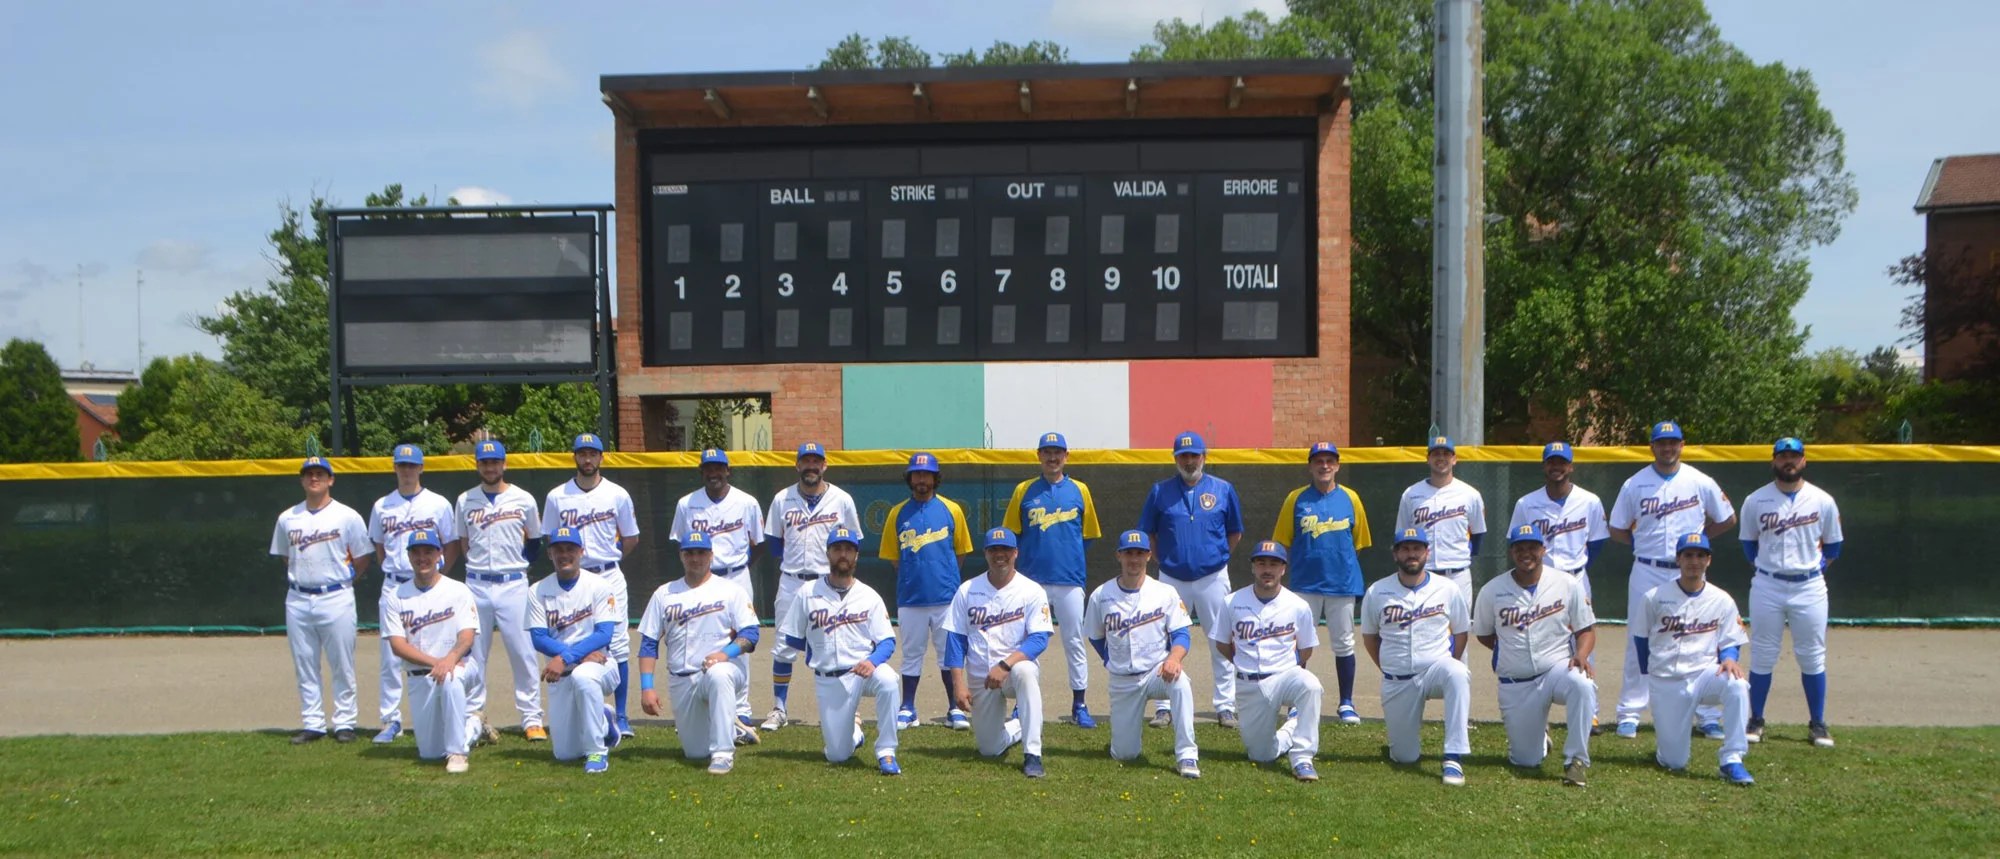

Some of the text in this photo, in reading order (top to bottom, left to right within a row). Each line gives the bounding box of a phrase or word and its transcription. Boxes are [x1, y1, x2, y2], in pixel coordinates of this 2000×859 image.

[770, 188, 815, 204] BALL
[890, 185, 936, 201] STRIKE
[1007, 182, 1045, 198] OUT
[1113, 180, 1167, 197] VALIDA
[1223, 179, 1279, 195] ERRORE
[674, 264, 1278, 299] 1 2 3 4 5 6 7 8 9 10 TOTALI
[467, 508, 524, 530] Modena
[560, 508, 616, 529] Modena
[1414, 504, 1466, 528] Modena
[1640, 494, 1699, 520] Modena
[383, 515, 436, 537] Modena
[785, 511, 838, 532] Modena
[1760, 511, 1818, 536] Modena
[288, 529, 340, 551] Modena
[401, 606, 455, 634] Modena
[664, 600, 724, 625] Modena
[809, 609, 870, 634] Modena
[968, 606, 1024, 631] Modena
[1104, 607, 1164, 637] Modena
[1384, 603, 1445, 630] Modena
[1500, 599, 1564, 631] Modena
[1236, 620, 1294, 646] Modena
[1661, 615, 1718, 639] Modena
